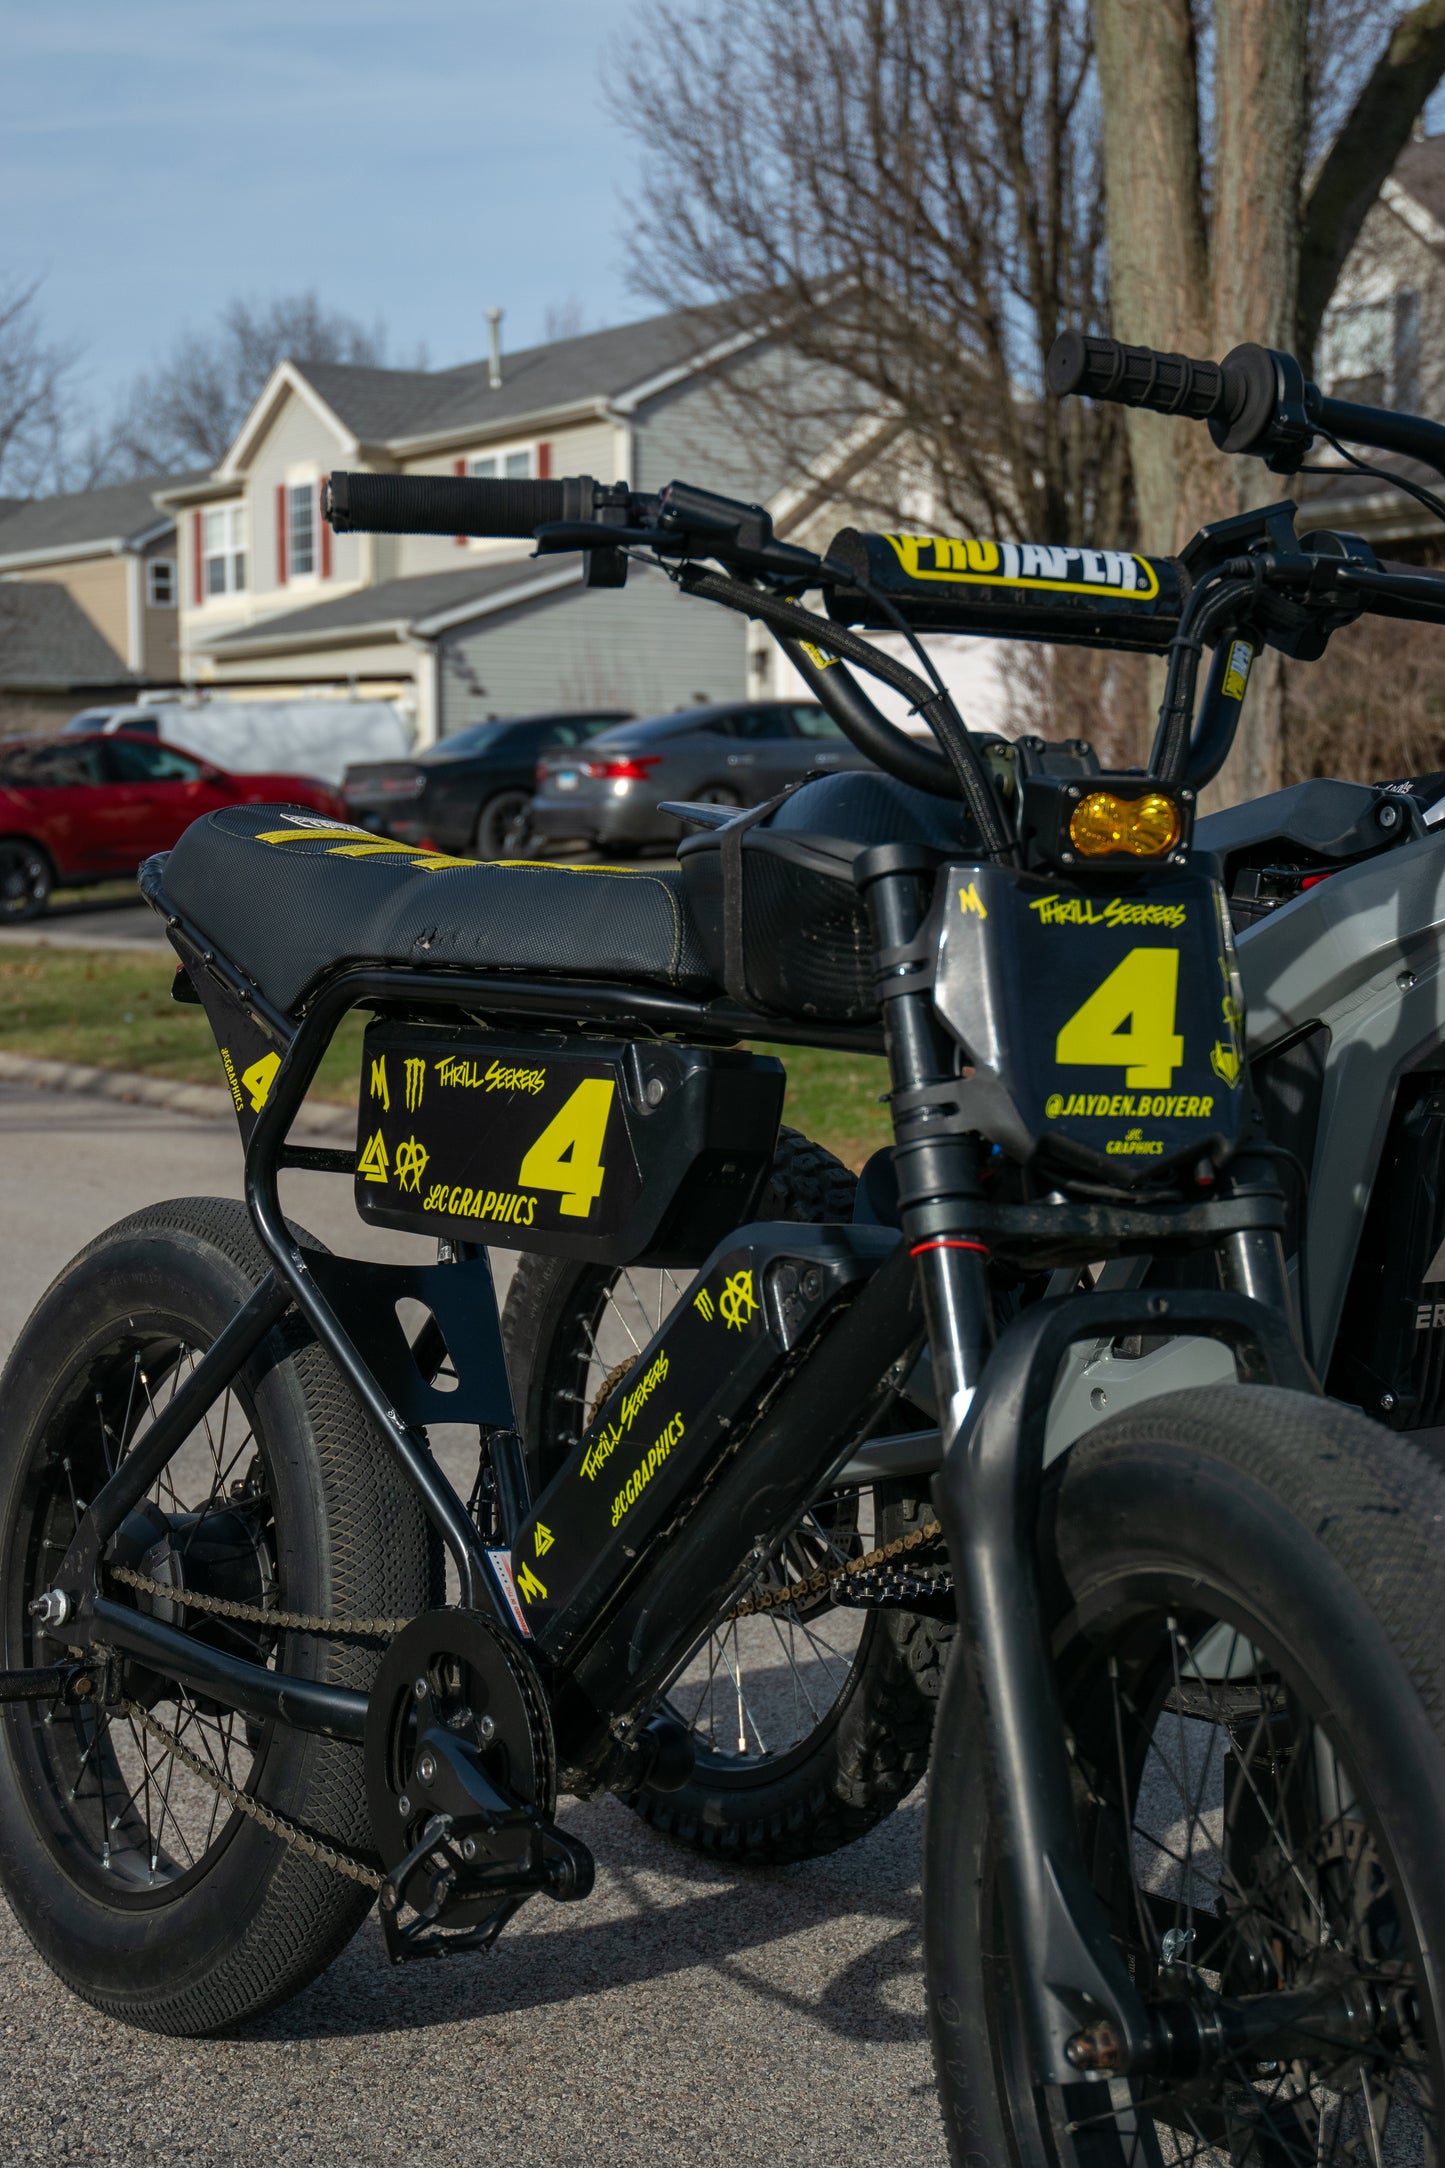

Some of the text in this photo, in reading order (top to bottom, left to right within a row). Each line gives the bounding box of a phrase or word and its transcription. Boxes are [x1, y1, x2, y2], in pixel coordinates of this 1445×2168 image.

[1103, 897, 1187, 929] SEEKERS
[1055, 947, 1185, 1090] 4
[240, 1050, 283, 1114] 4
[484, 1059, 547, 1096] SEEKERS
[1045, 1094, 1214, 1119] @JAYDEN.BOYERR
[517, 1077, 616, 1219] 4
[1105, 1140, 1164, 1156] GRAPHICS
[620, 1349, 670, 1432] SEEKERS
